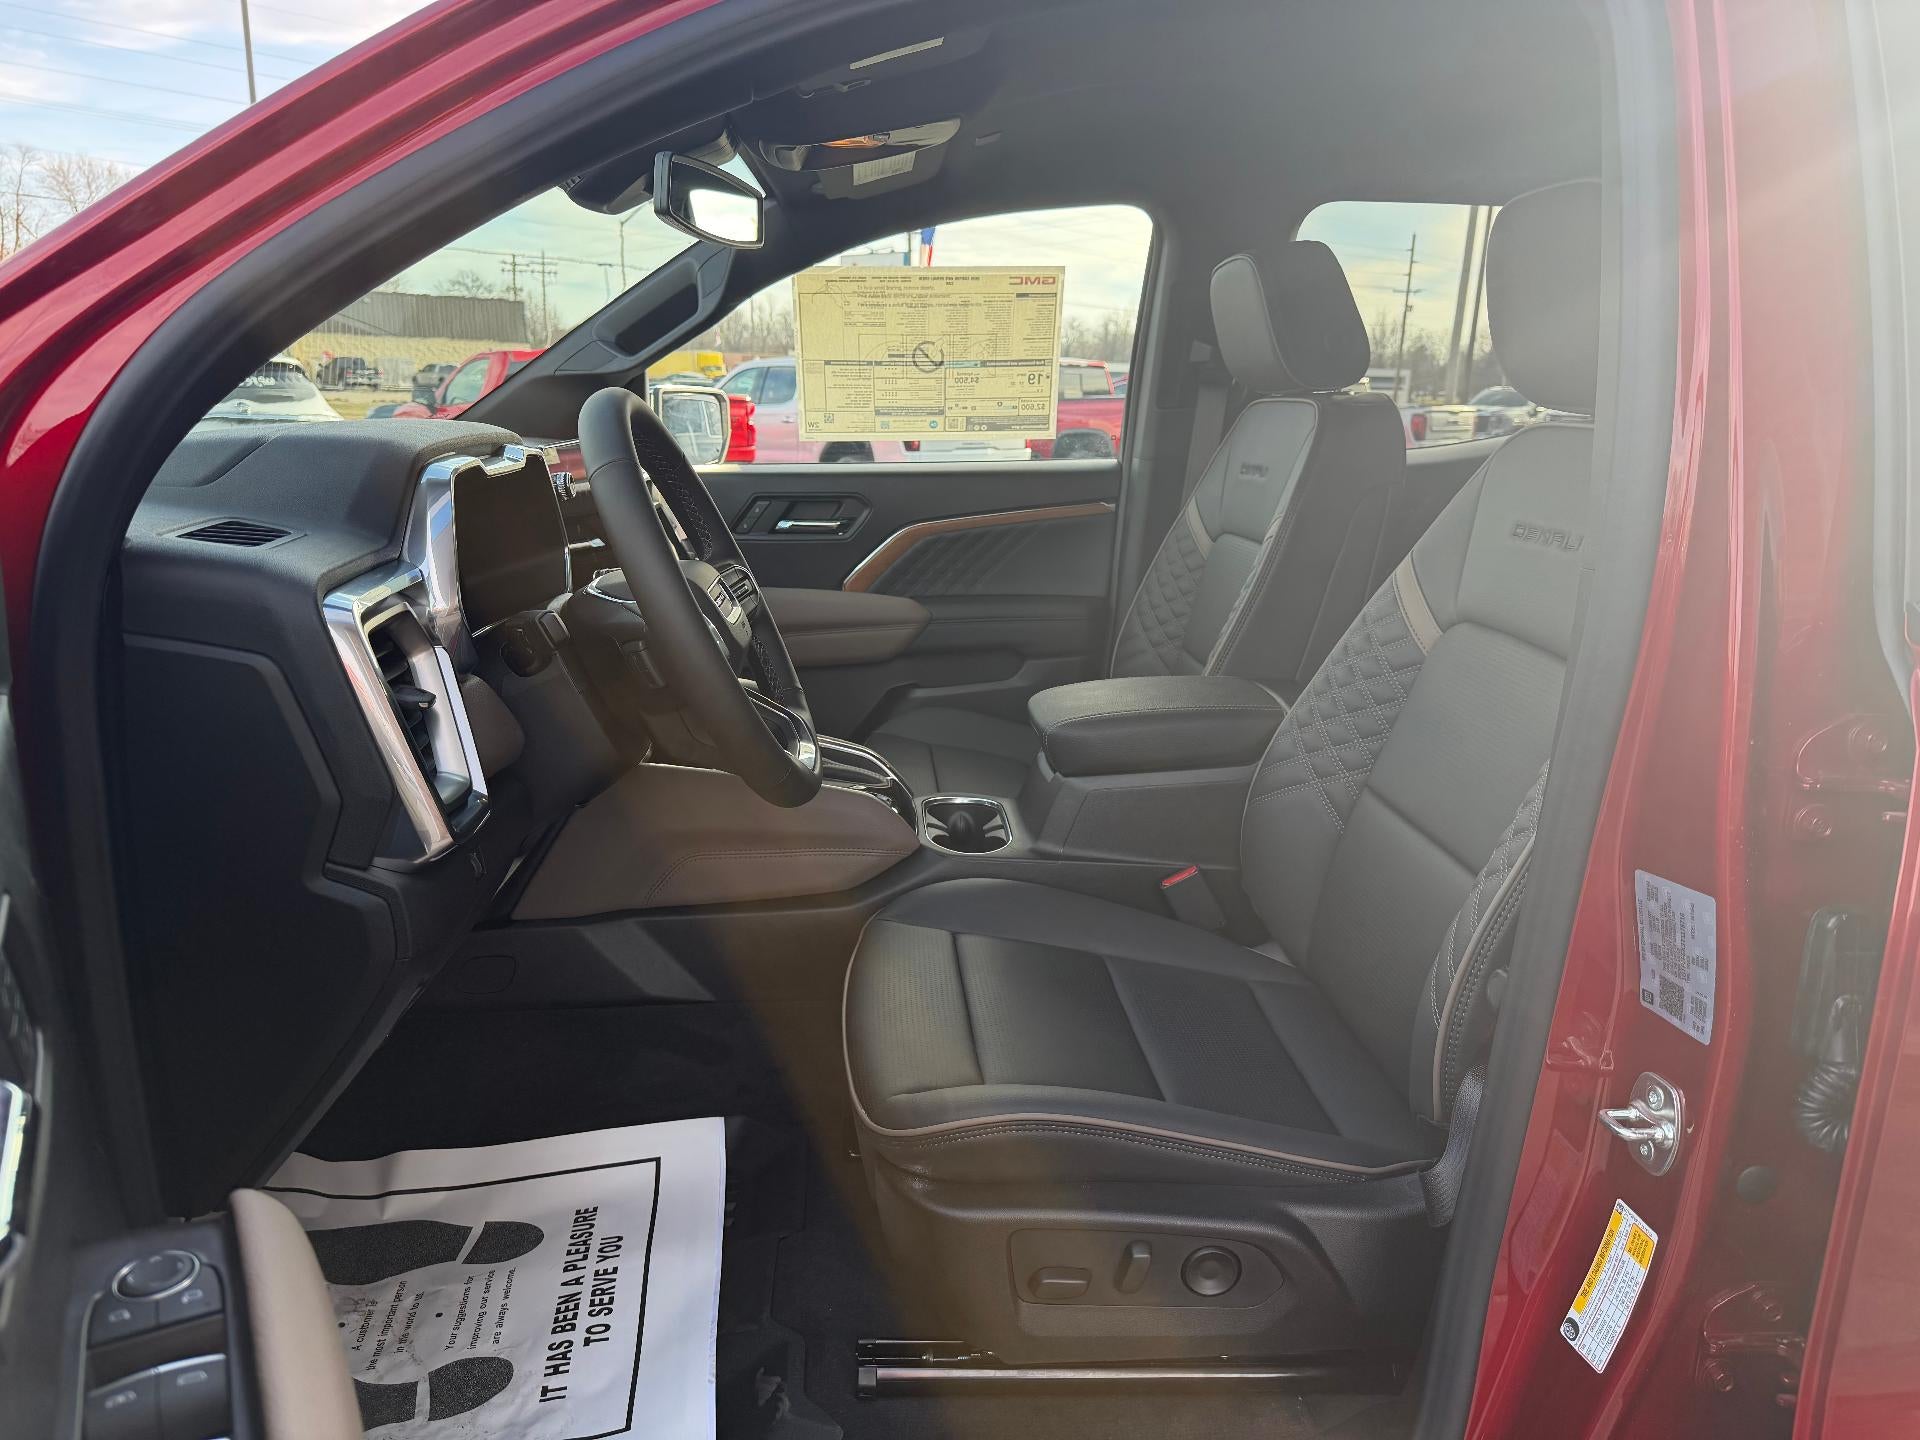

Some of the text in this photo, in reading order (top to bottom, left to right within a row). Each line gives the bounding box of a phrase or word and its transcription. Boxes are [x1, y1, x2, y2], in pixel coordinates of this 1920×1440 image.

[356, 1309, 375, 1343] customer
[365, 1281, 407, 1371] the most important person
[403, 1312, 416, 1330] world
[444, 1276, 473, 1351] Your suggestions for
[467, 1270, 495, 1349] improving our service
[492, 1267, 516, 1344] are always welcome.
[539, 1206, 598, 1402] IT HAS BEEN A PLEASURE
[583, 1236, 623, 1347] TO SERVE YOU
[398, 1333, 409, 1344] the
